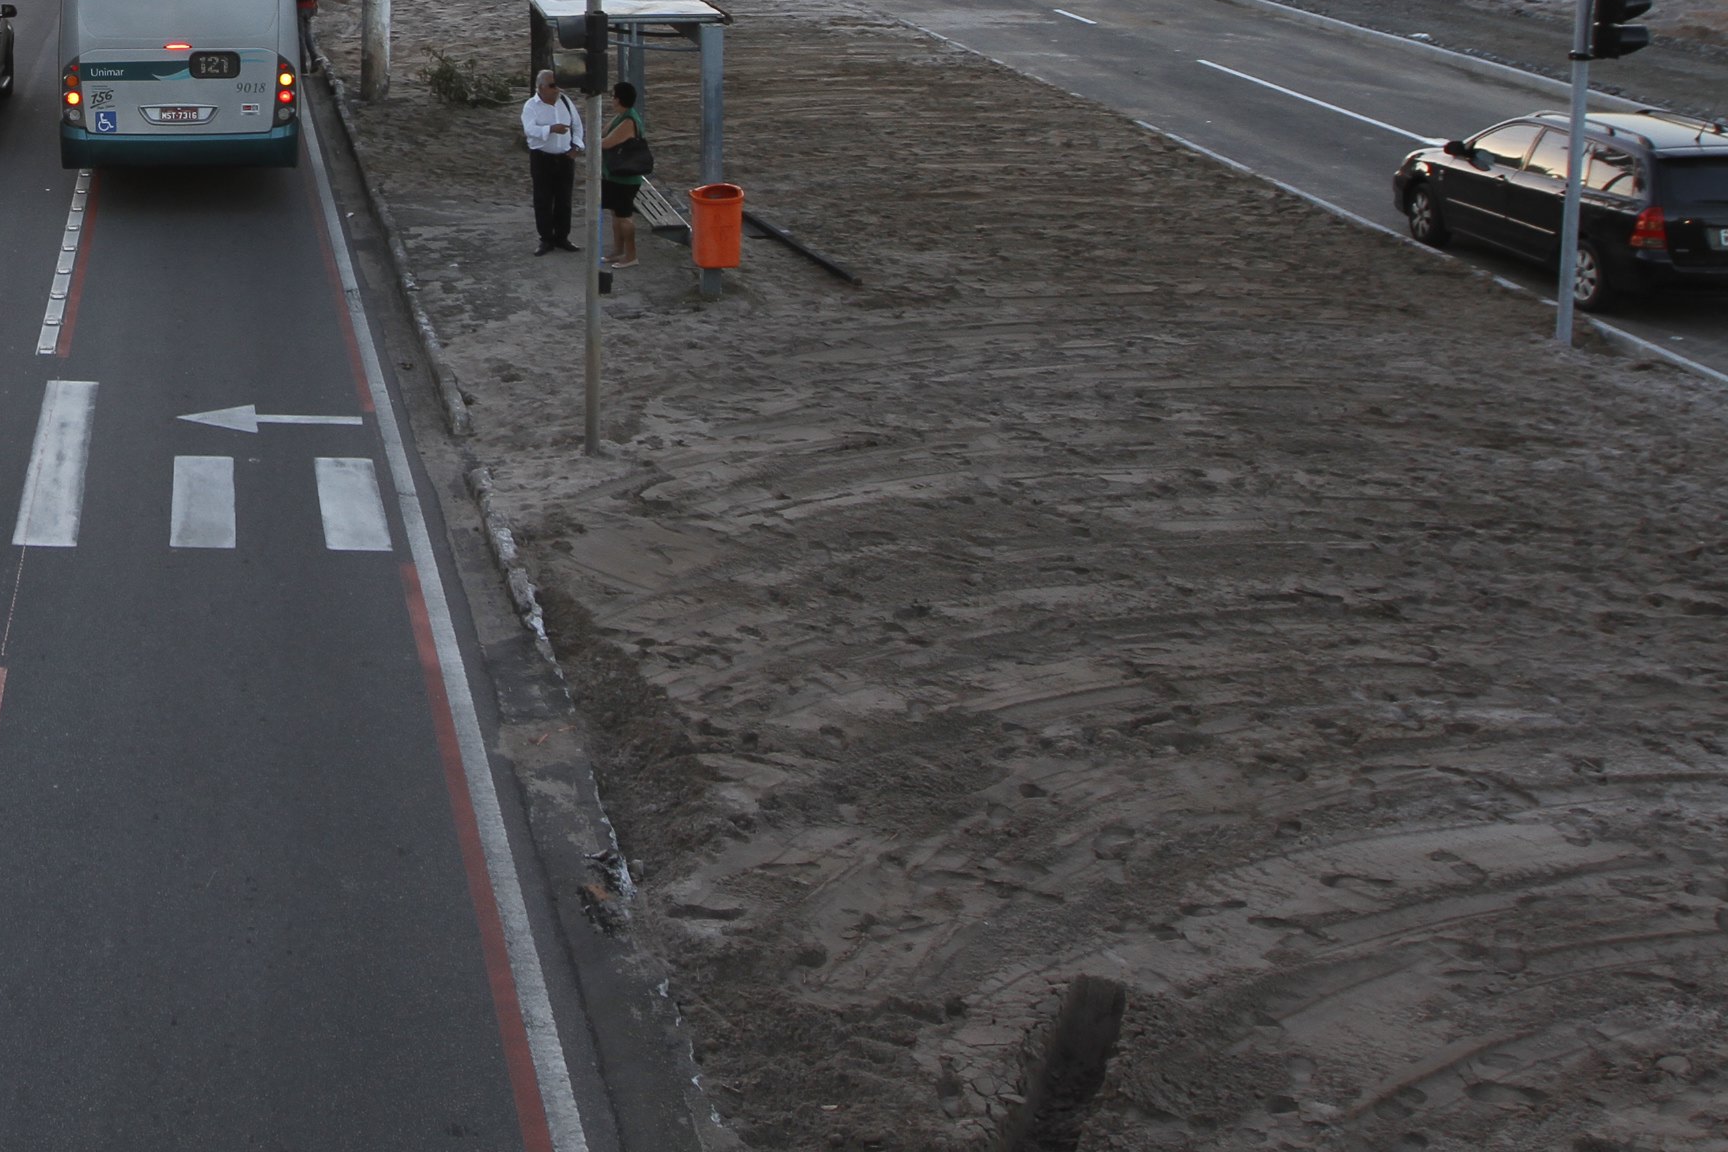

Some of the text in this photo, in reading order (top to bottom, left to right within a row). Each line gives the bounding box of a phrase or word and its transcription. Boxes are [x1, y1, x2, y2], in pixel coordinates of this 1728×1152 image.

[90, 67, 124, 77] Unimar
[236, 83, 266, 93] 9018
[91, 90, 114, 105] 156
[161, 111, 198, 120] MST-7316
